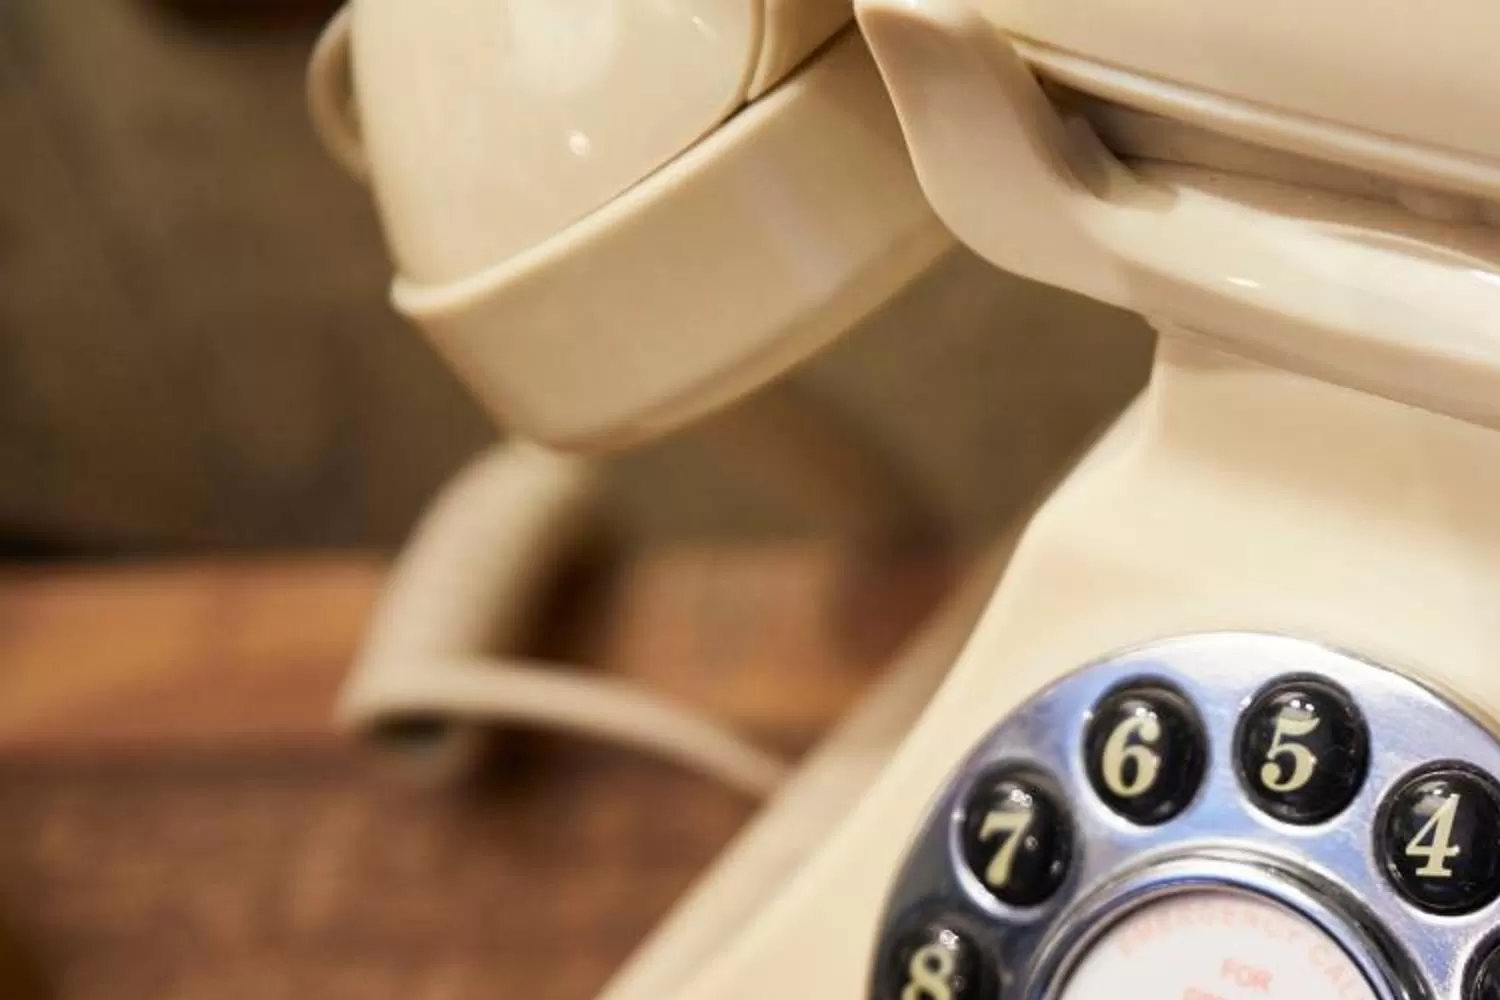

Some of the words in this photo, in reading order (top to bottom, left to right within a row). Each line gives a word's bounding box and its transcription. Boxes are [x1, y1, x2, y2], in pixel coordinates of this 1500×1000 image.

[1103, 714, 1161, 797] 6
[1261, 706, 1320, 792] 5
[979, 808, 1030, 886] 7
[1405, 793, 1461, 877] 4
[1220, 957, 1273, 993] FOR
